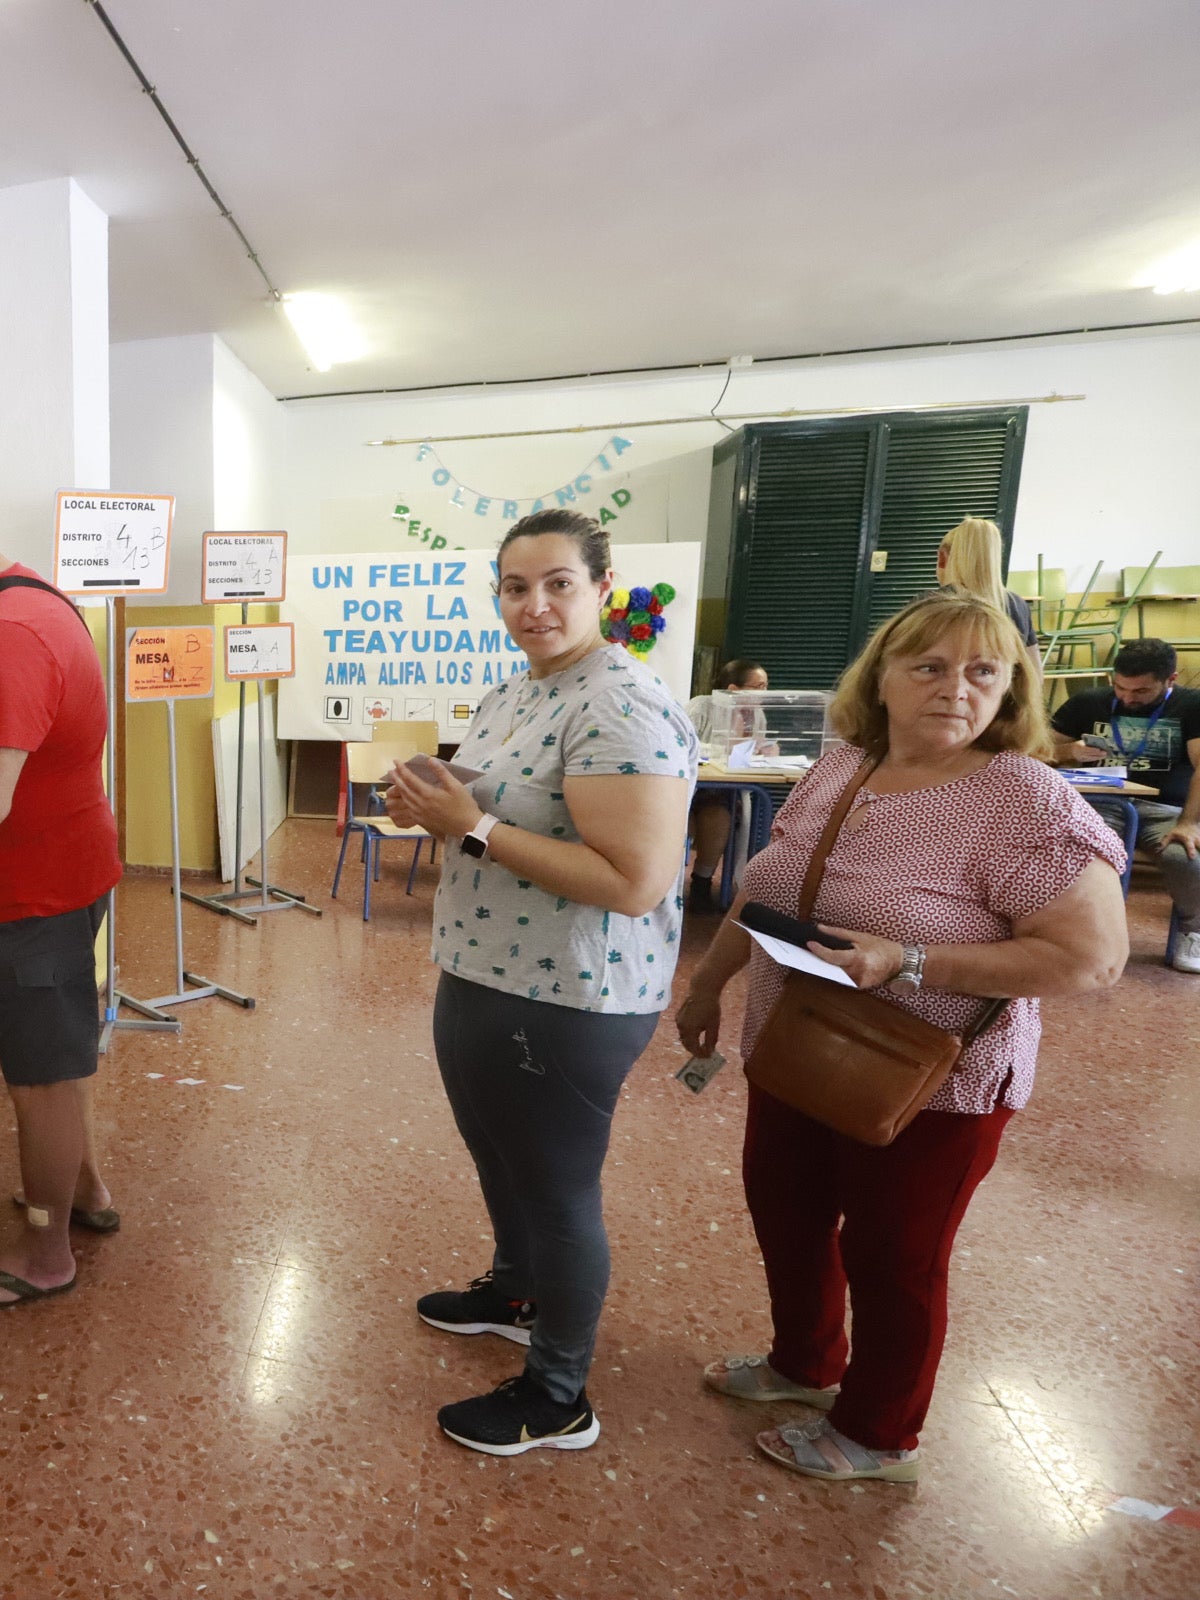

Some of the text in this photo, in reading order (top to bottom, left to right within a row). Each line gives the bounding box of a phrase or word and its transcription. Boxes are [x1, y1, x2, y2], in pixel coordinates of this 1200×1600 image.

[64, 500, 156, 511] LOCAL ELECTORAL
[62, 523, 166, 551] DISTRITO 4 B
[208, 538, 233, 546] LOCAL
[61, 545, 151, 571] SECCIONES 13
[312, 565, 353, 589] UN
[368, 561, 467, 588] FELIZ
[343, 599, 403, 623] POR
[426, 594, 469, 620] LA
[135, 652, 170, 665] MESA
[229, 644, 258, 653] MESA
[325, 661, 367, 685] AMPA
[378, 660, 426, 685] ALIFA
[436, 660, 473, 685] LOS
